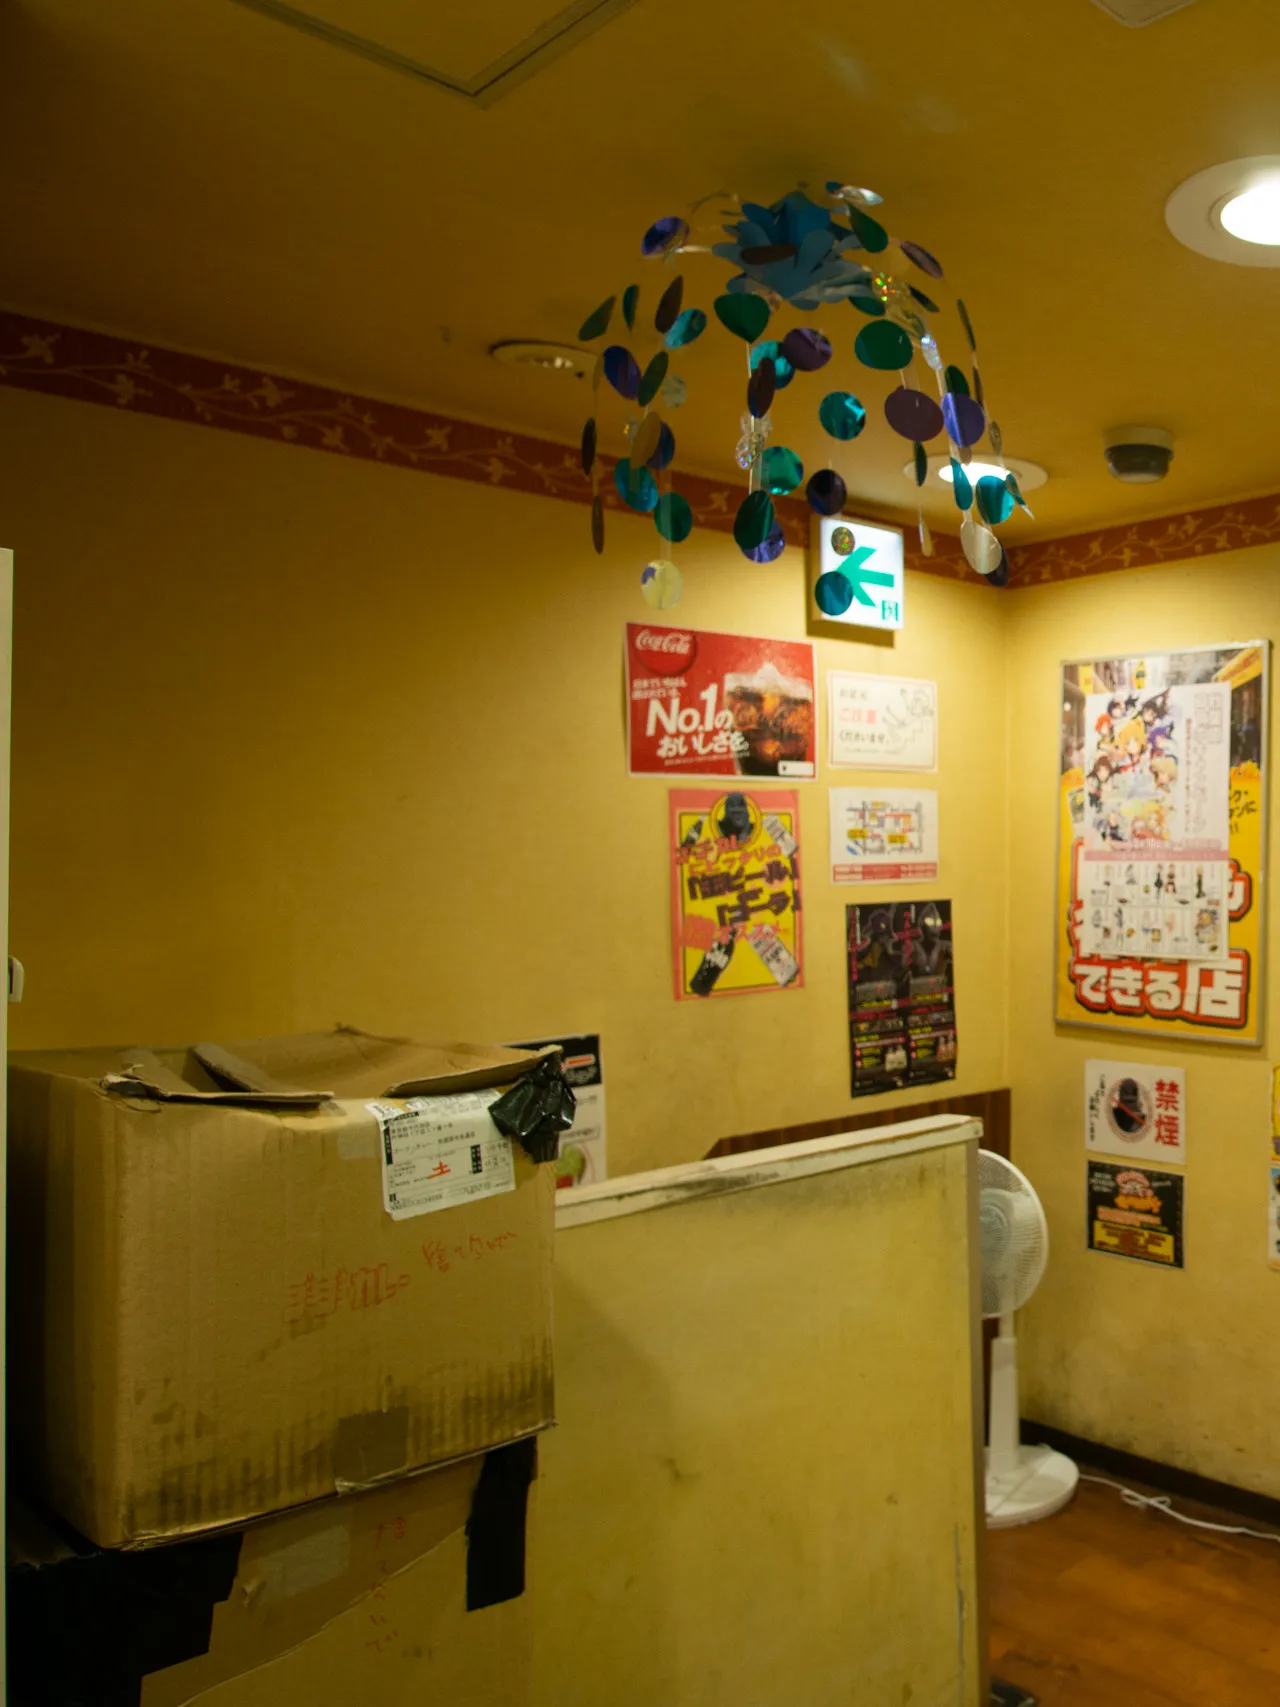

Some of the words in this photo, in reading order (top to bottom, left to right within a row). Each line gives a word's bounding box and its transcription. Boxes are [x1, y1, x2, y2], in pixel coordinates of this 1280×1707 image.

[1073, 957, 1244, 1020] できる店
[1154, 1079, 1180, 1148] 禁煙
